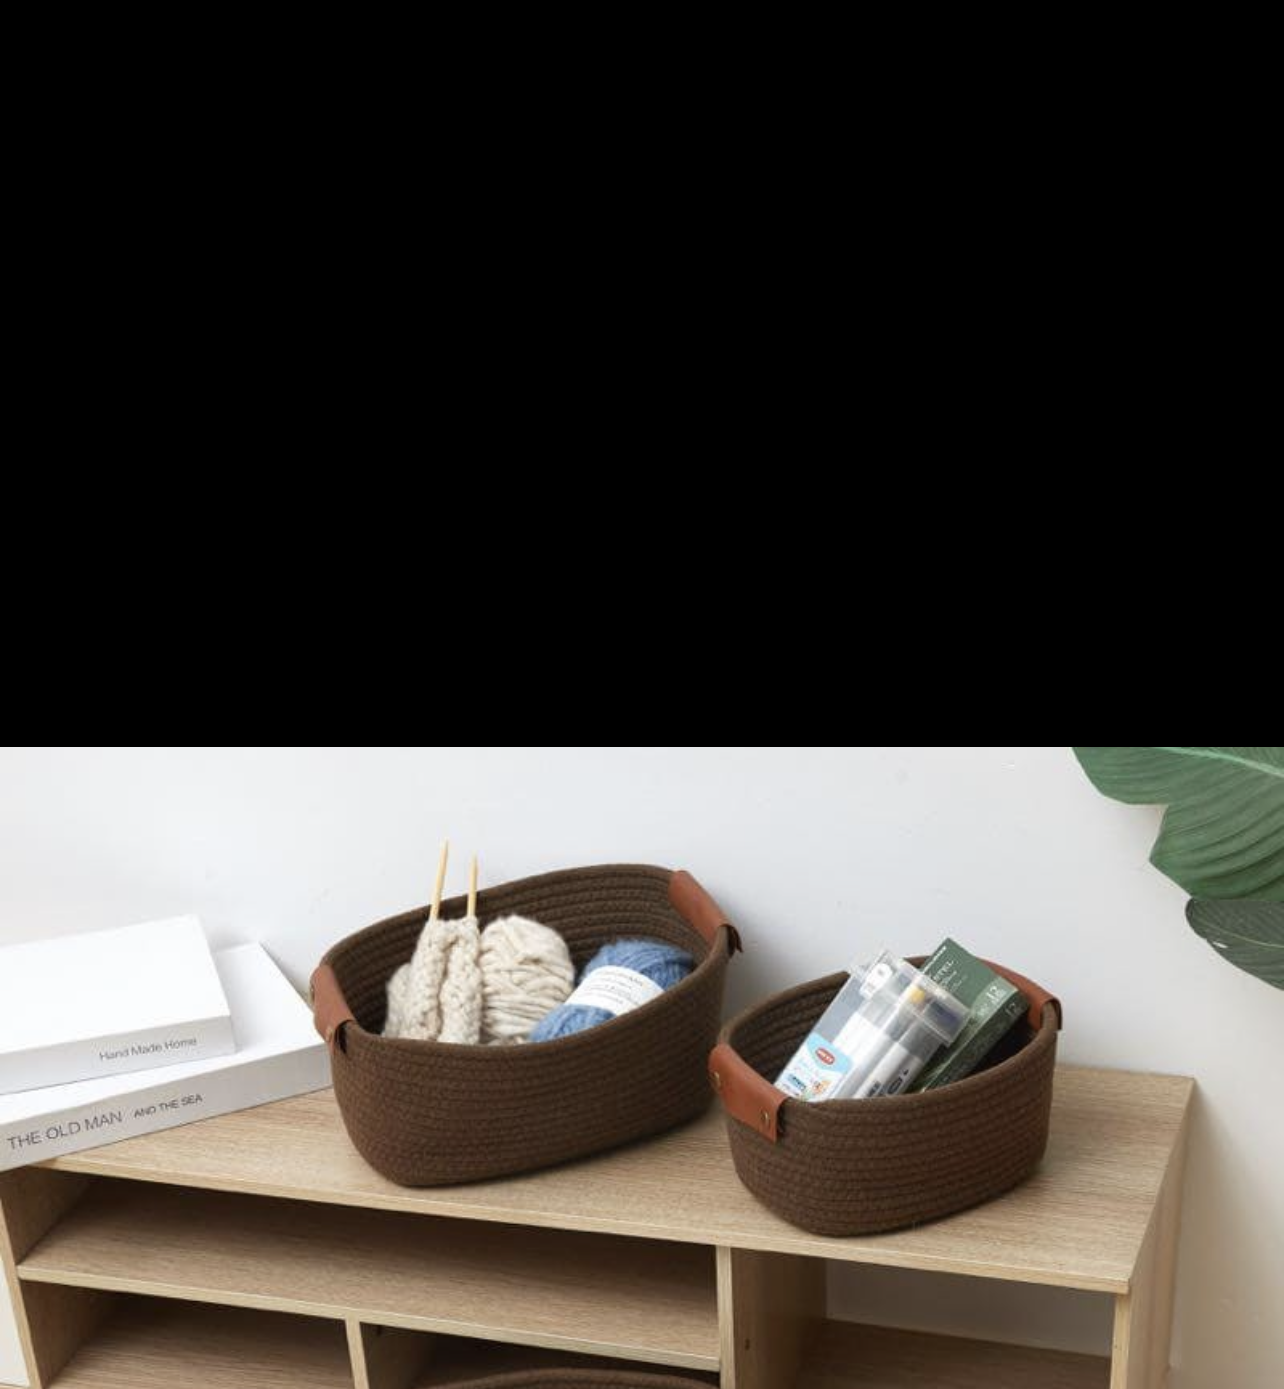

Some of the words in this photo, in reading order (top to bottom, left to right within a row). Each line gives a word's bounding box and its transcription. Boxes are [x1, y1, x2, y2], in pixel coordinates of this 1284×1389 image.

[98, 1050, 129, 1061] Hand
[131, 1043, 163, 1056] Made
[164, 1037, 197, 1051] Home
[6, 1131, 42, 1150] THE
[46, 1120, 81, 1140] OLD
[84, 1111, 122, 1130] MAN
[134, 1105, 157, 1118] AND
[159, 1099, 179, 1112] THE
[181, 1093, 203, 1106] SEA
